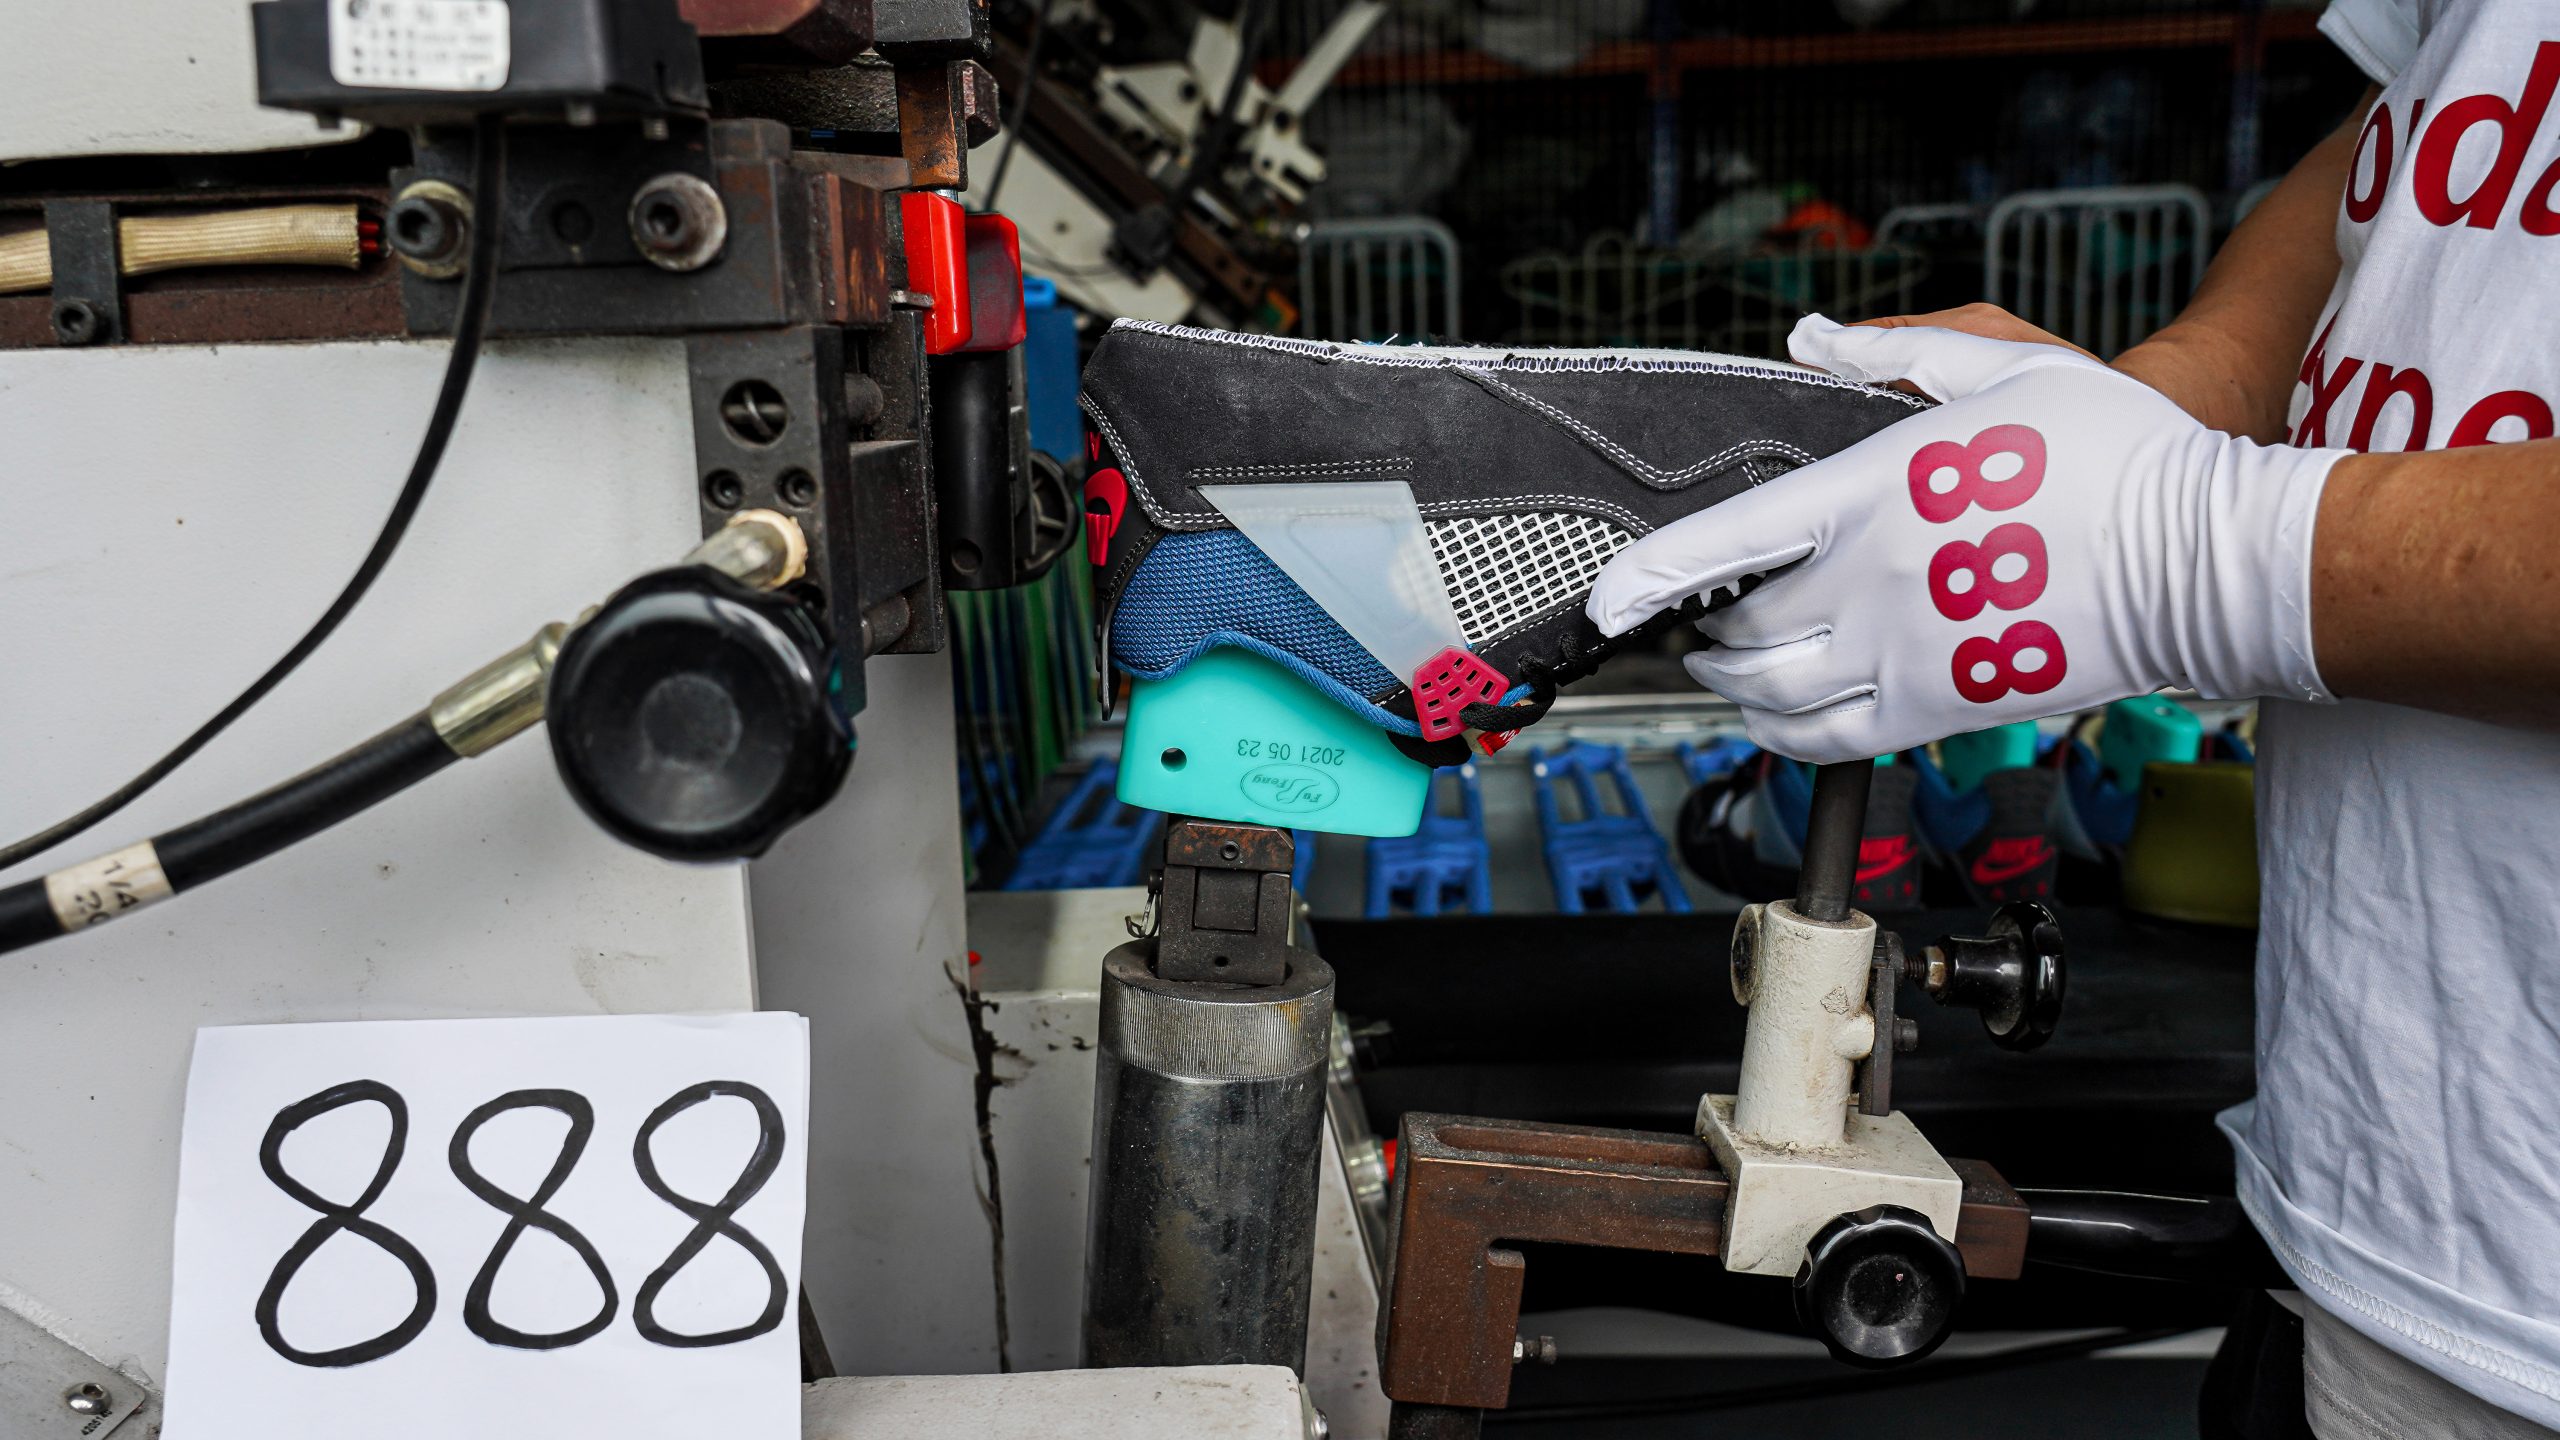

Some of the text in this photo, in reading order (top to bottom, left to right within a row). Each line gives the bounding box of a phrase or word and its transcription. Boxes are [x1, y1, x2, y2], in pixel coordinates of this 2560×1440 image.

[1907, 423, 2068, 704] 888
[1237, 739, 1345, 766] 2021 05 23
[1251, 773, 1290, 789] Feng
[1303, 792, 1322, 803] Fu
[255, 1078, 790, 1369] 888
